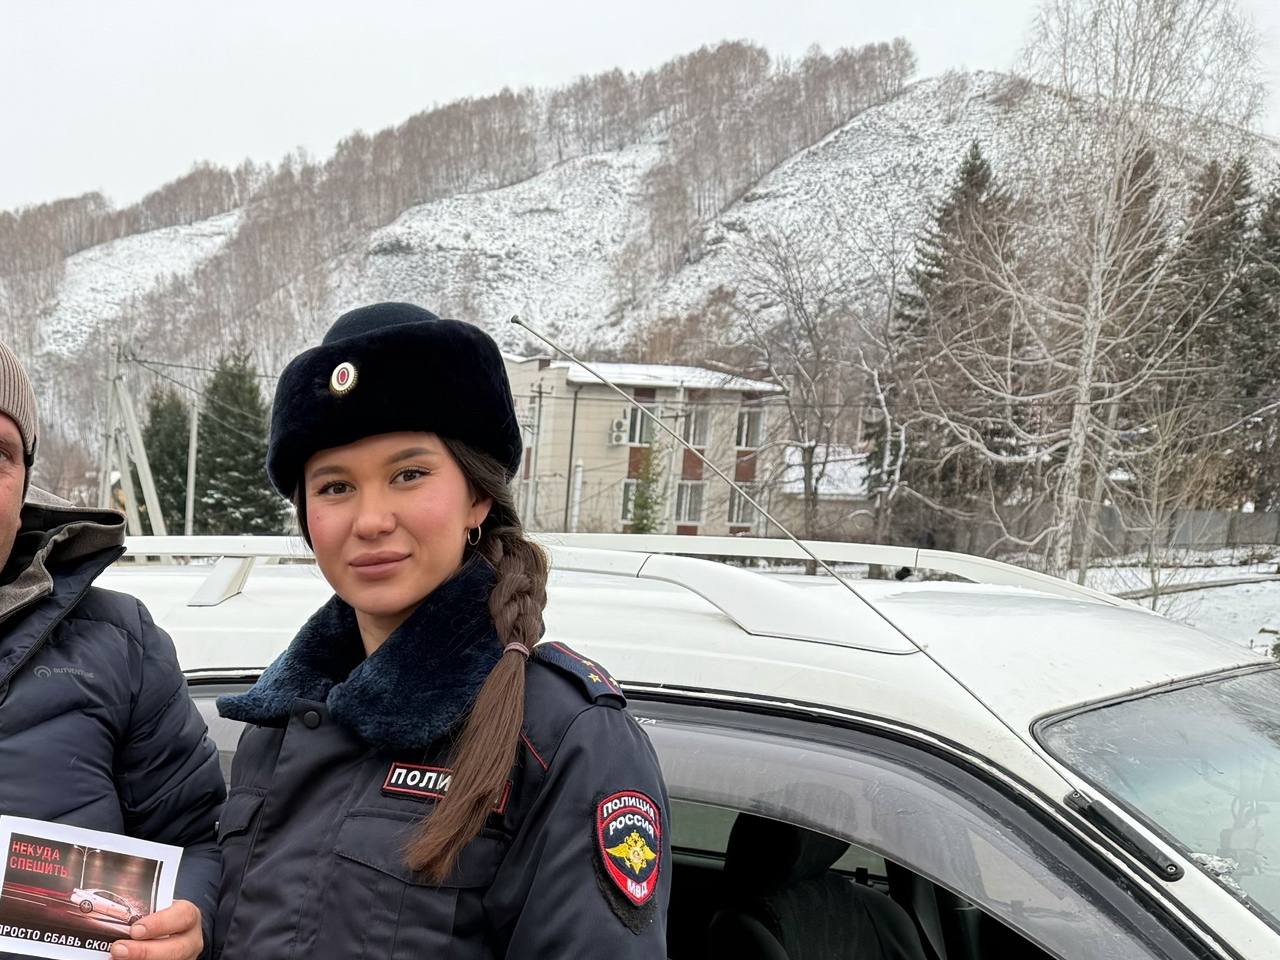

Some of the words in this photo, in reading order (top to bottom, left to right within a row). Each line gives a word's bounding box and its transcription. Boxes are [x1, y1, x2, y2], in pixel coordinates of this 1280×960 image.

[390, 768, 452, 792] ПОЛИ
[603, 796, 656, 820] ПОЛИЦИЯ
[609, 813, 655, 839] РОССИЯ
[11, 841, 61, 862] НЕКУДА
[10, 856, 69, 877] СПЕШИТЬ
[626, 879, 649, 898] МВД
[44, 932, 81, 947] СБАВЬ
